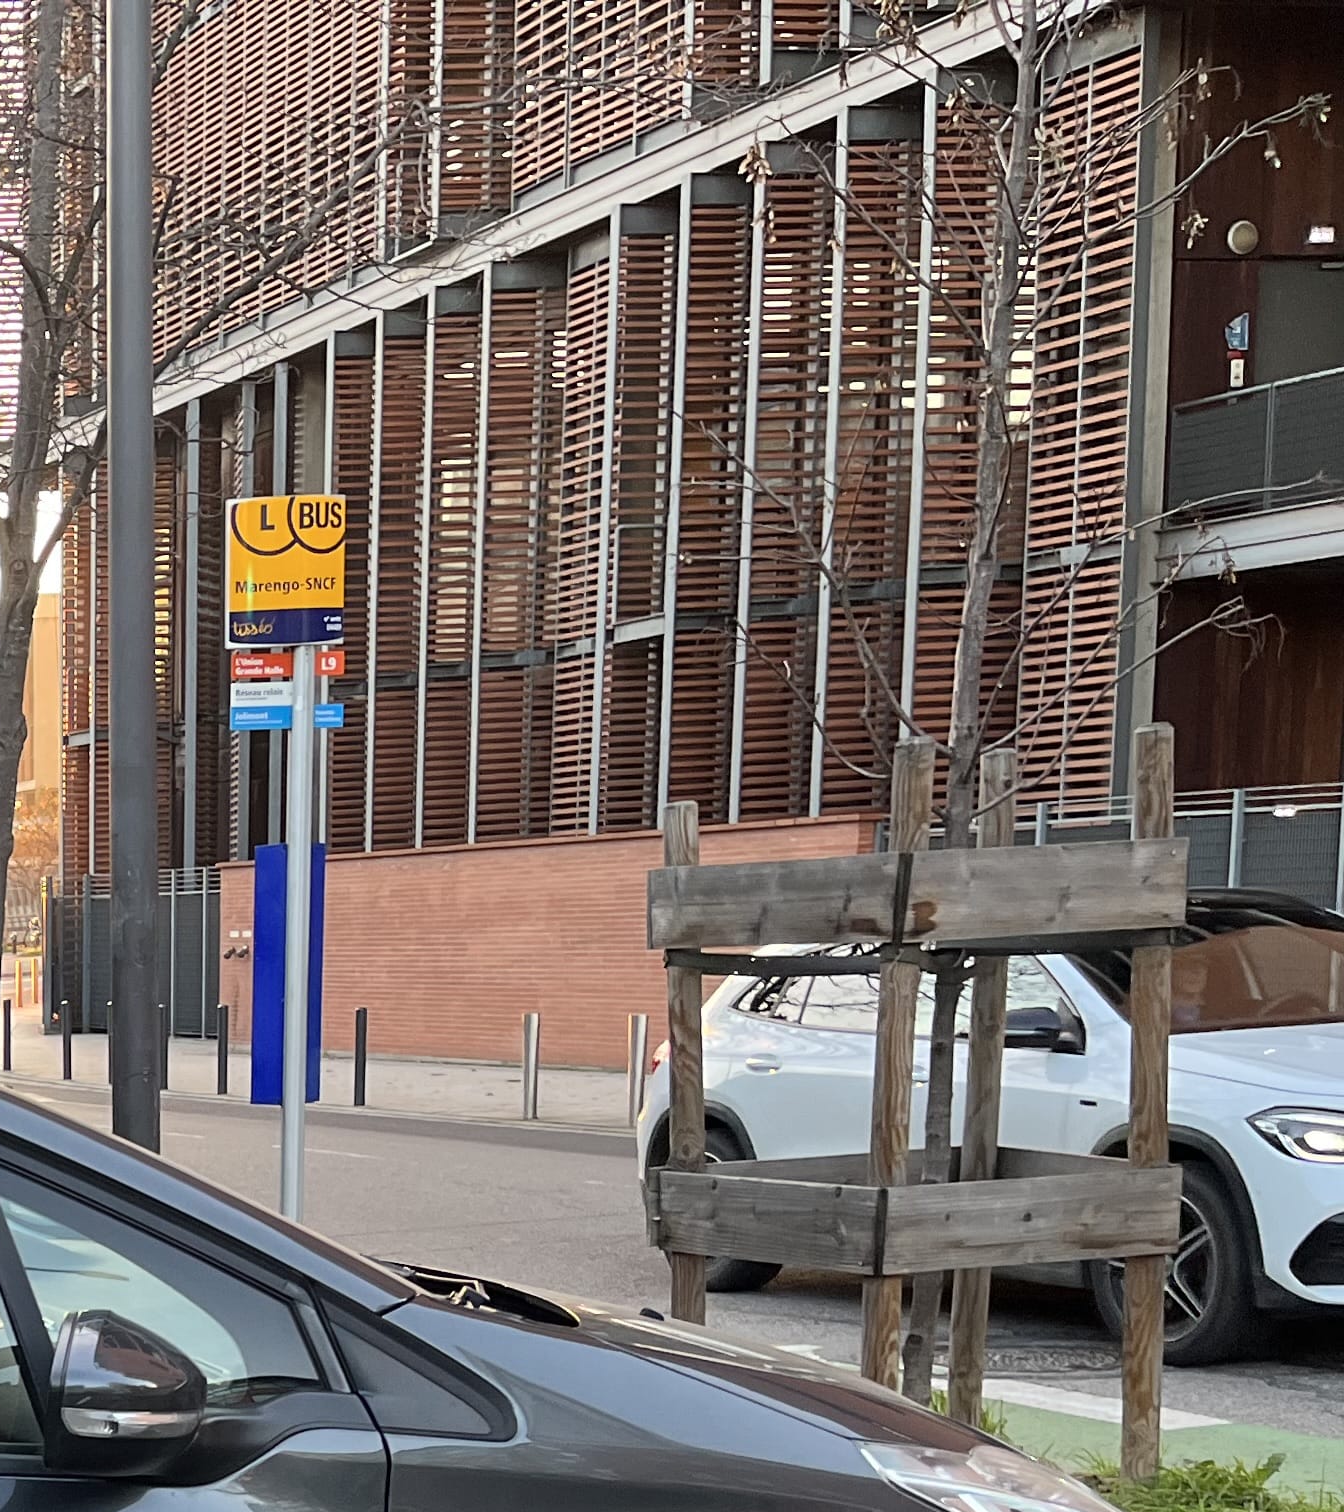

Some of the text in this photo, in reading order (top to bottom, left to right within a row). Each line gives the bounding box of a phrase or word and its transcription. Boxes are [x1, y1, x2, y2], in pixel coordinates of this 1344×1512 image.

[259, 504, 275, 531] L
[299, 502, 342, 530] BUS
[235, 577, 337, 595] Marengo-SNCF
[321, 657, 337, 671] L9
